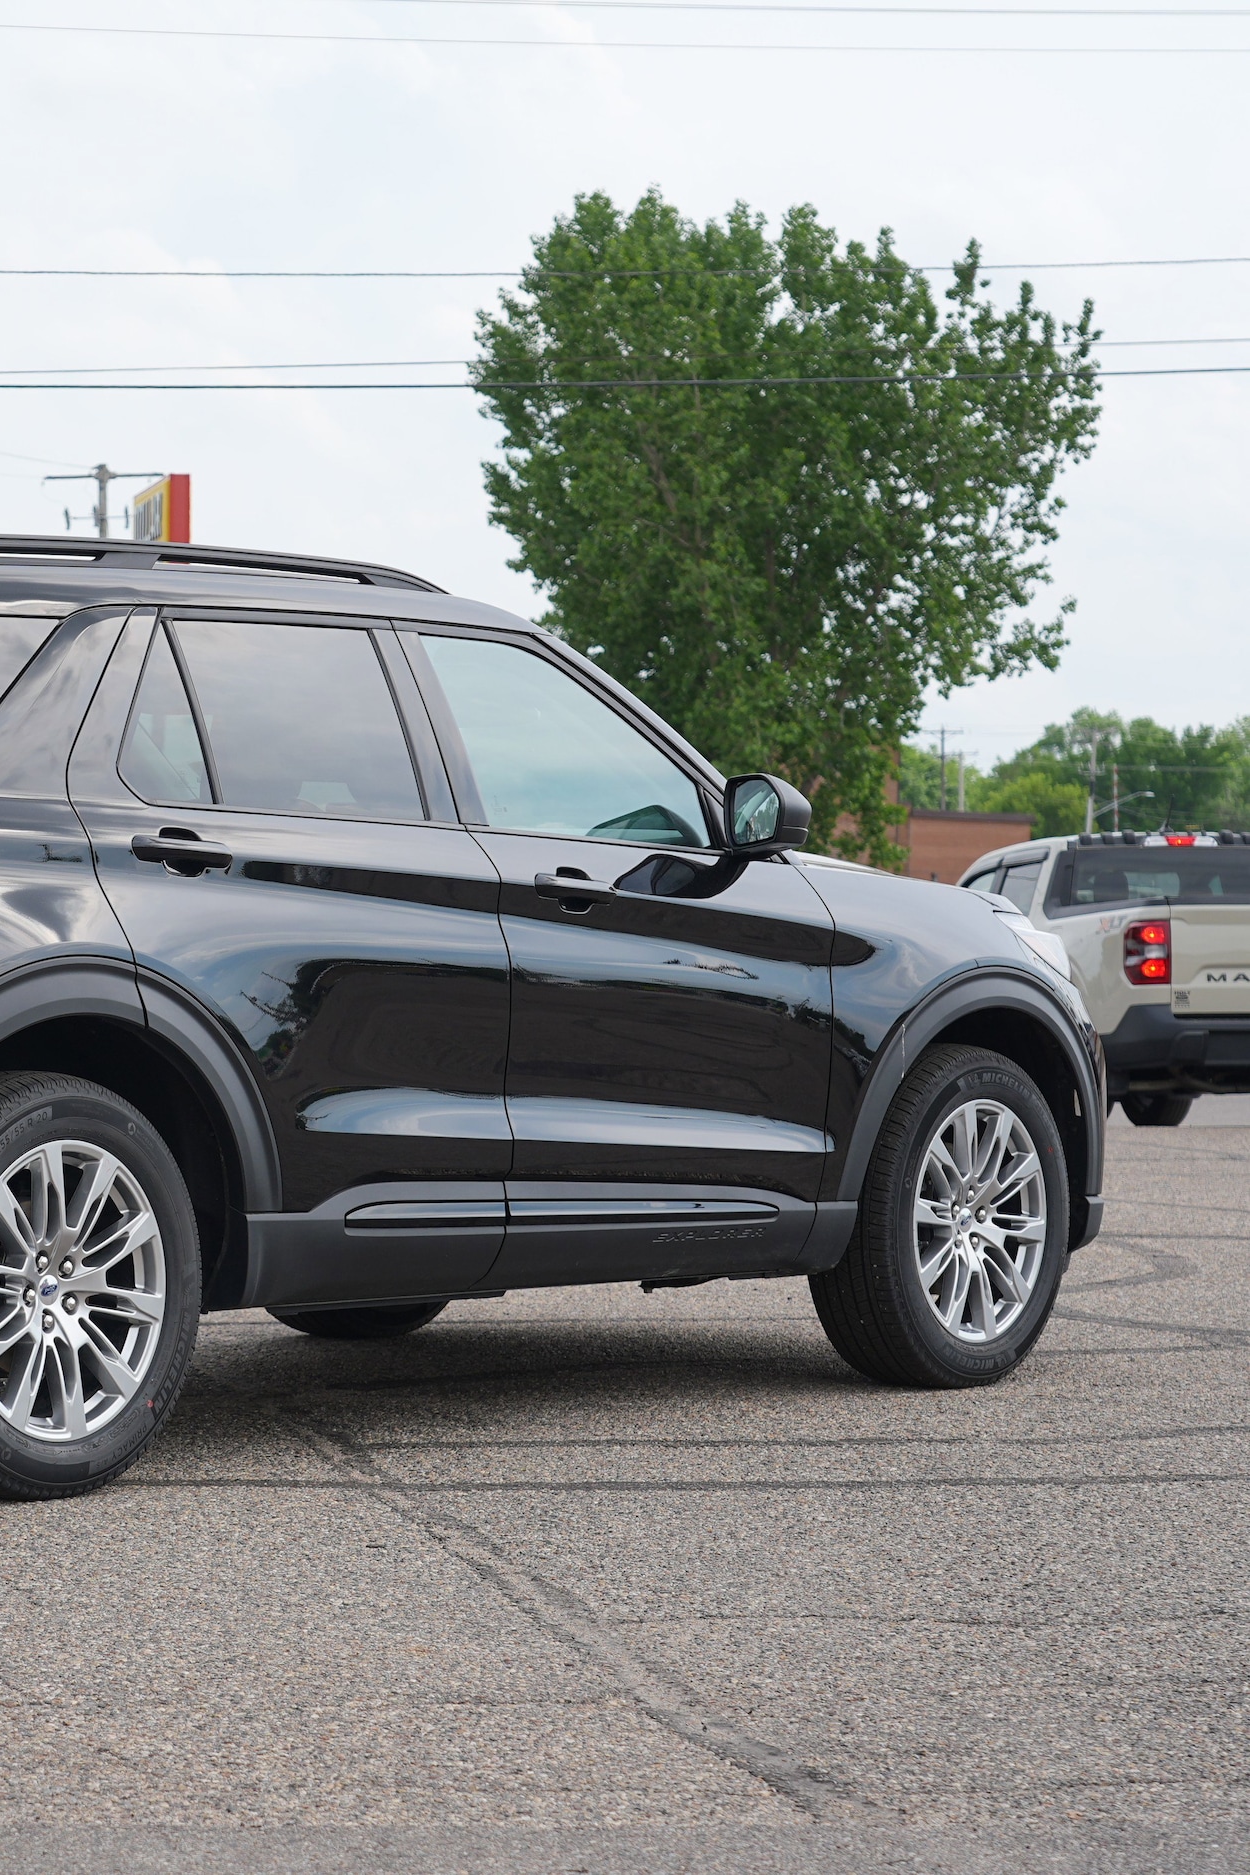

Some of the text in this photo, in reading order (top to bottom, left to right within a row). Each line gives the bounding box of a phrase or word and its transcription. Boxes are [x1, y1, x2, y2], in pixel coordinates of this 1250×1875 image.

[981, 1072, 1031, 1098] MICHELIN
[152, 1312, 192, 1415] MICHELIN
[112, 1423, 148, 1461] PRIMACY
